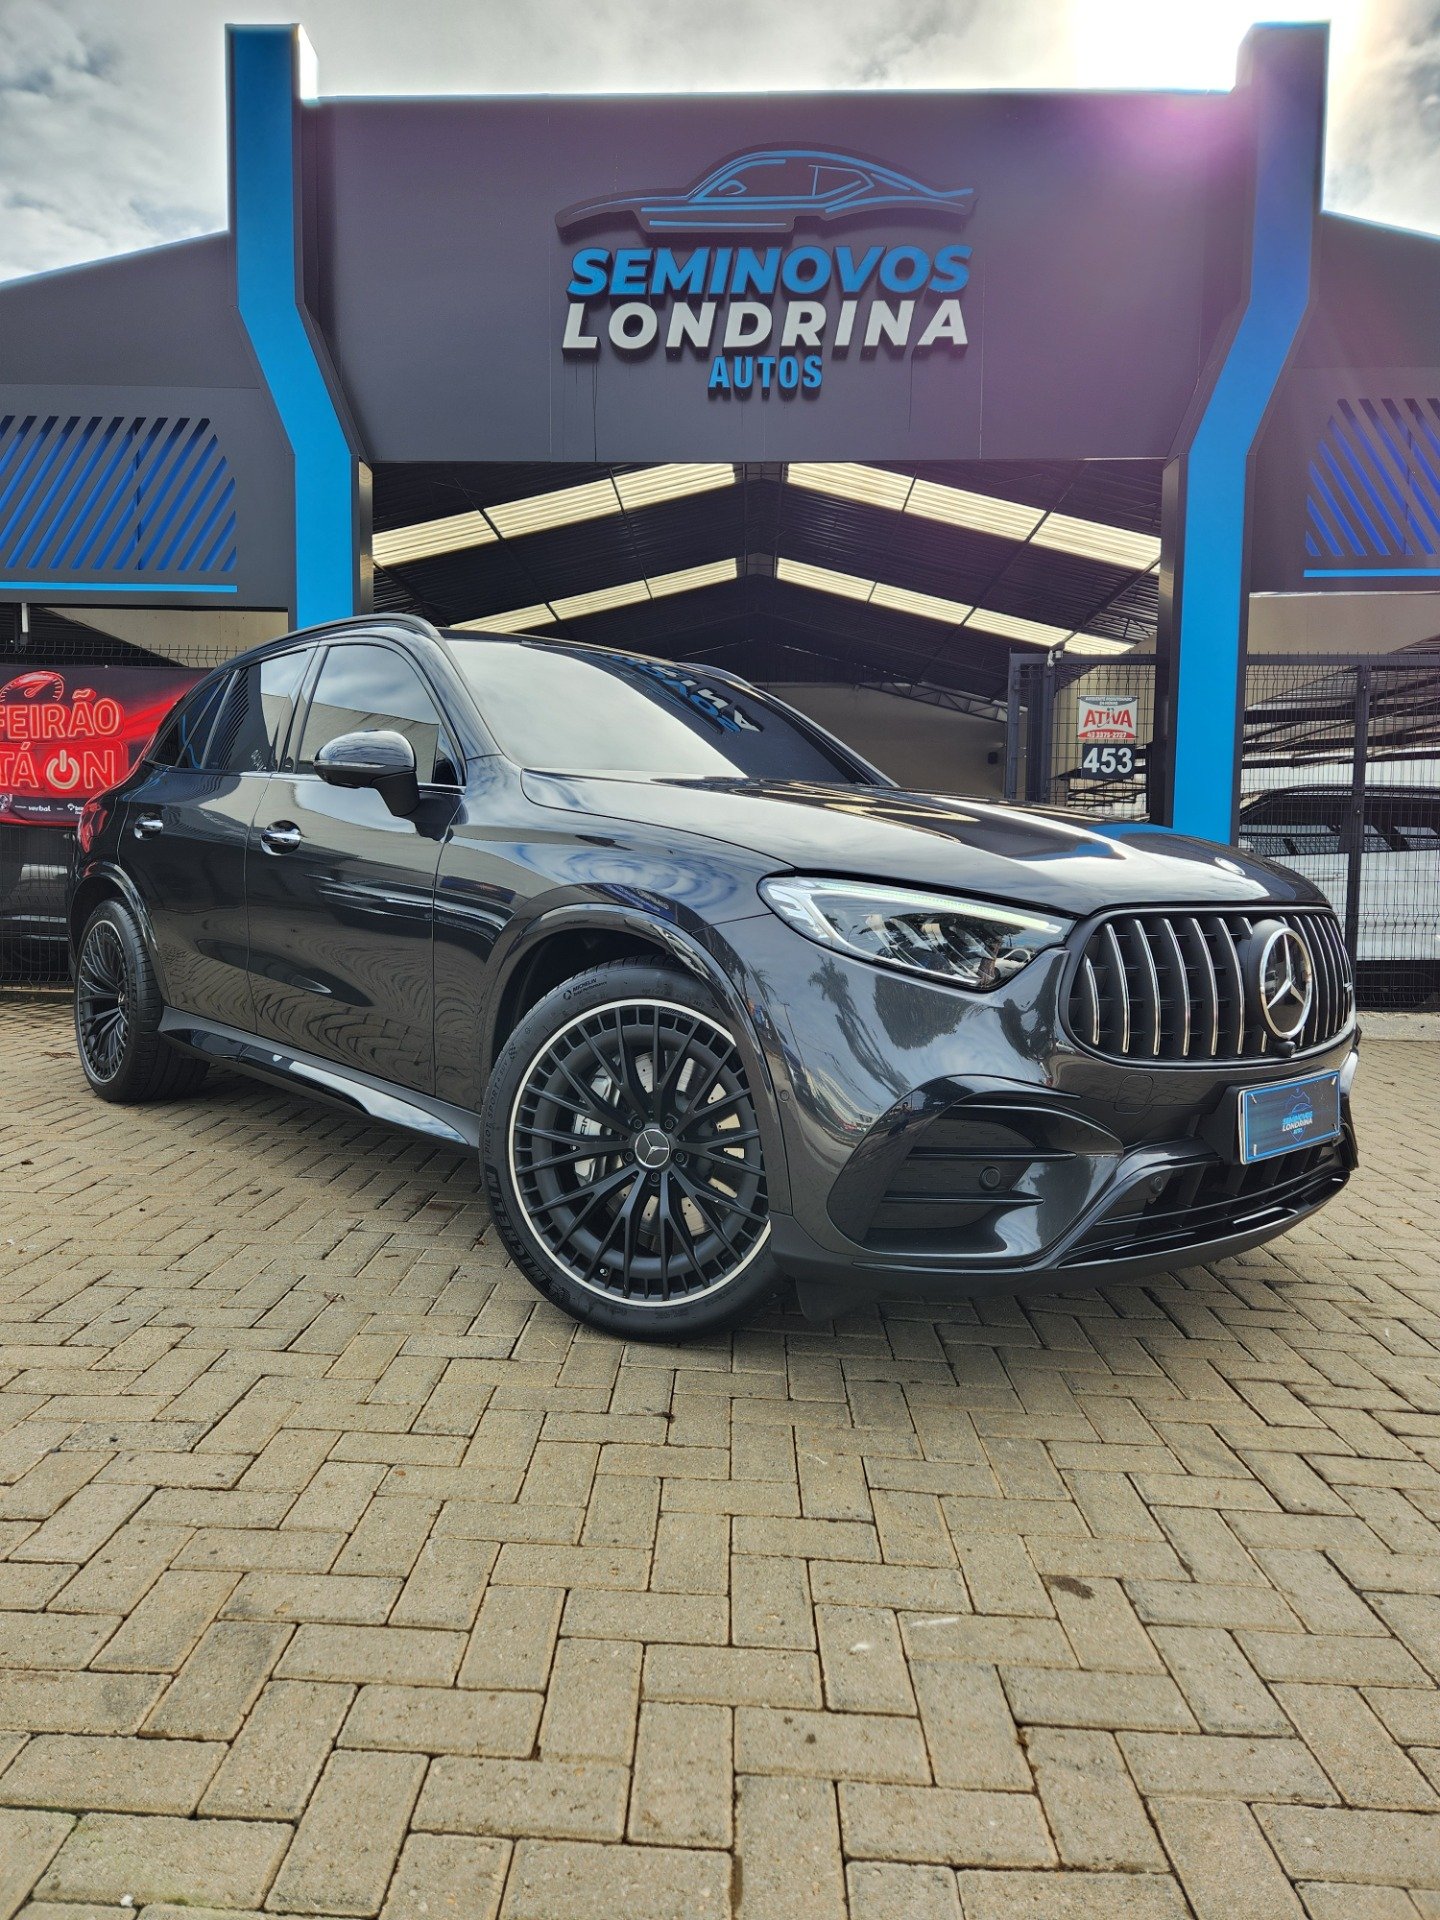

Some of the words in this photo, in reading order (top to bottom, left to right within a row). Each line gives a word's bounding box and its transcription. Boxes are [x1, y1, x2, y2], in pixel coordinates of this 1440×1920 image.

[567, 245, 974, 297] SEMINOVOS
[562, 299, 969, 350] LONDRINA
[708, 355, 823, 389] AUTOS
[1083, 708, 1133, 728] ATIVA
[1083, 747, 1133, 774] 453
[488, 1083, 501, 1120] SPORT
